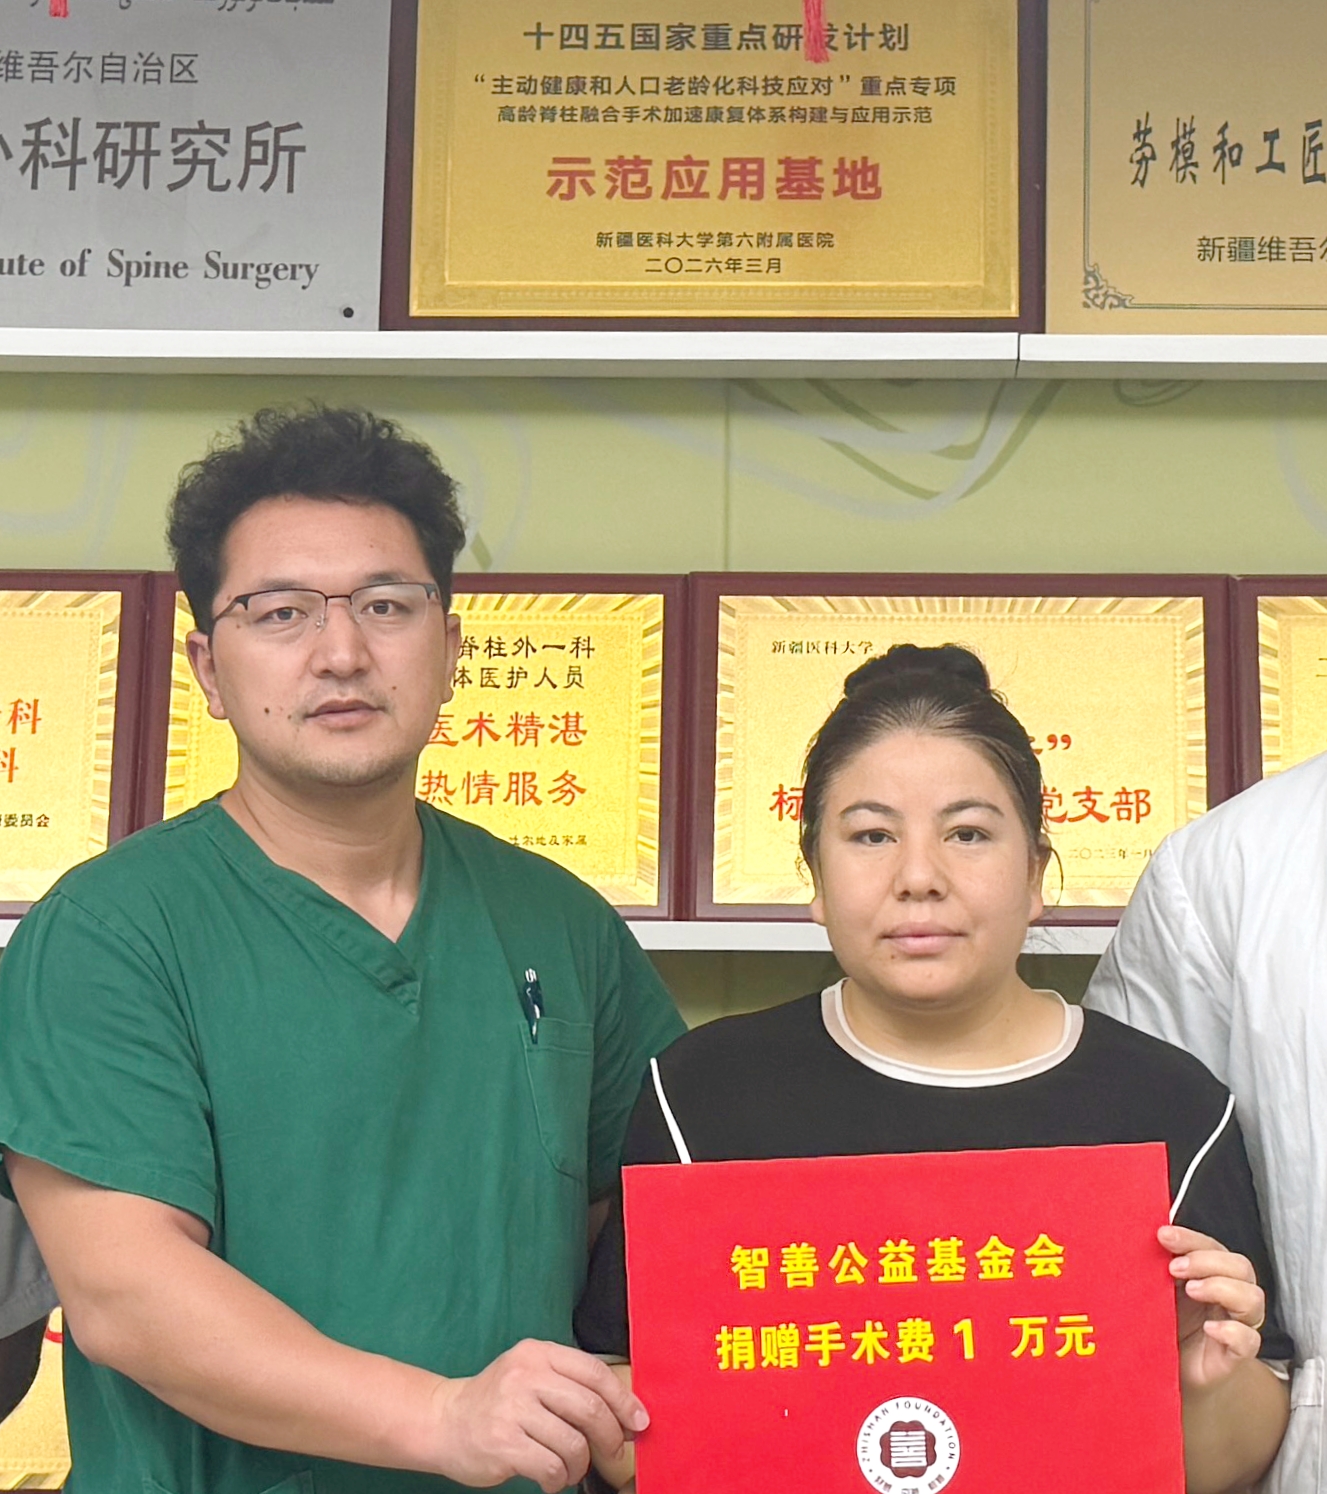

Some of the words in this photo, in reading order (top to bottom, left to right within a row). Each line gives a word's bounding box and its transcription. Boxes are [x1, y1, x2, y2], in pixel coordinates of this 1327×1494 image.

[546, 155, 884, 202] 示范应用基地
[596, 231, 836, 250] 新疆医科大学第六附属医院
[60, 248, 92, 278] of
[106, 249, 189, 286] Spine
[203, 251, 320, 289] Surgery
[418, 769, 587, 807] 热情服务
[731, 1232, 1066, 1290] 智善公益基金会
